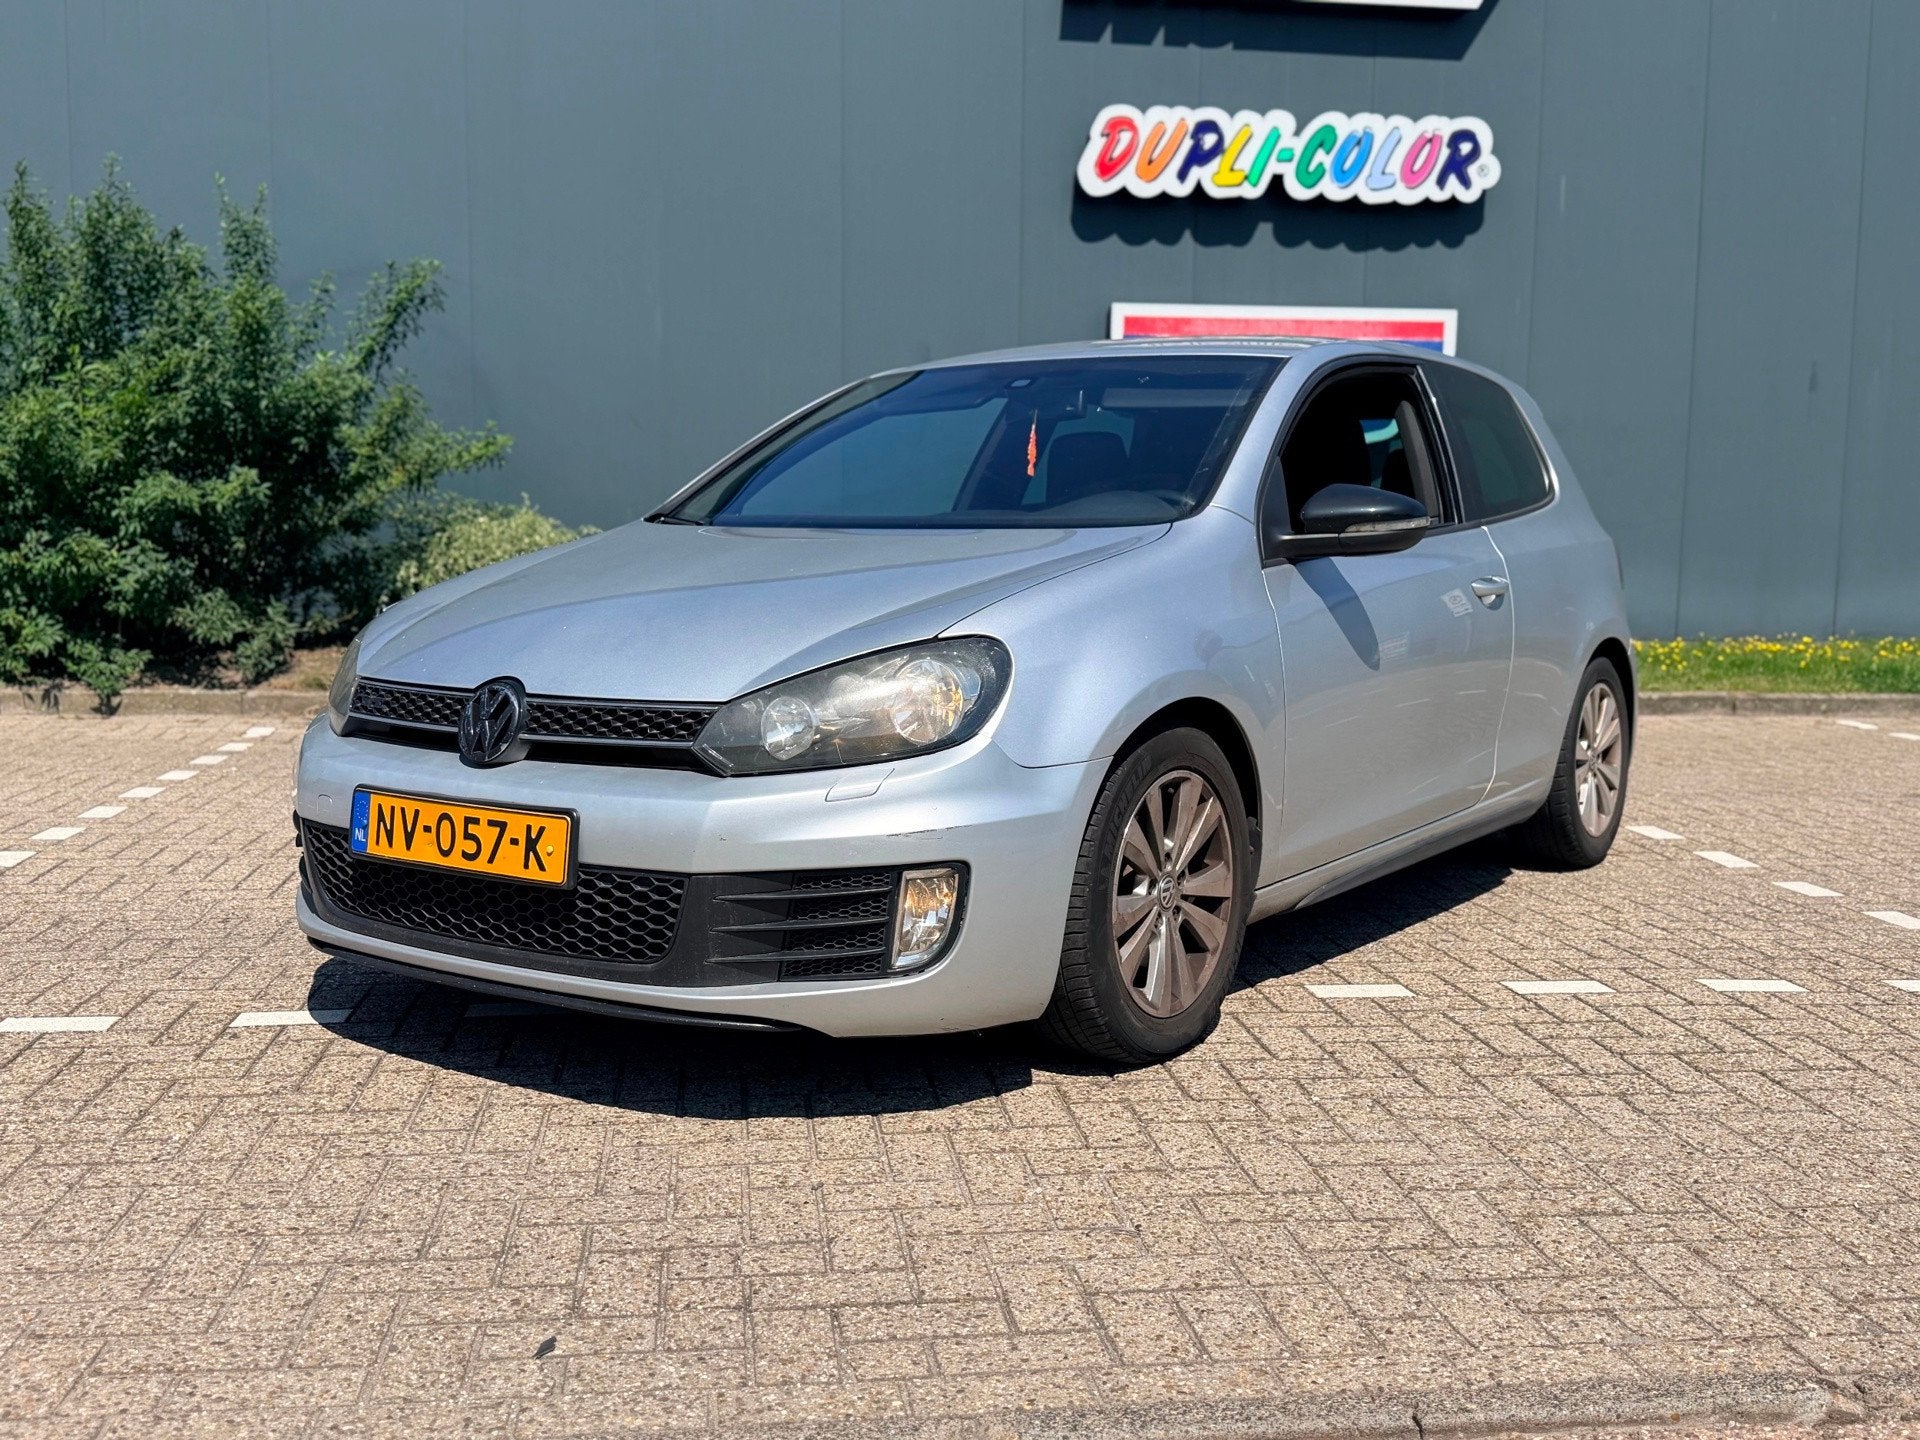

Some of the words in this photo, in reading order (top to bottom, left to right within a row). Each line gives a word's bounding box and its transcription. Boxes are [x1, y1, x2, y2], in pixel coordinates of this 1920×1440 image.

[1094, 116, 1481, 190] DUPLI-COLOR
[354, 828, 366, 842] NL
[376, 803, 546, 872] NV-057-K
